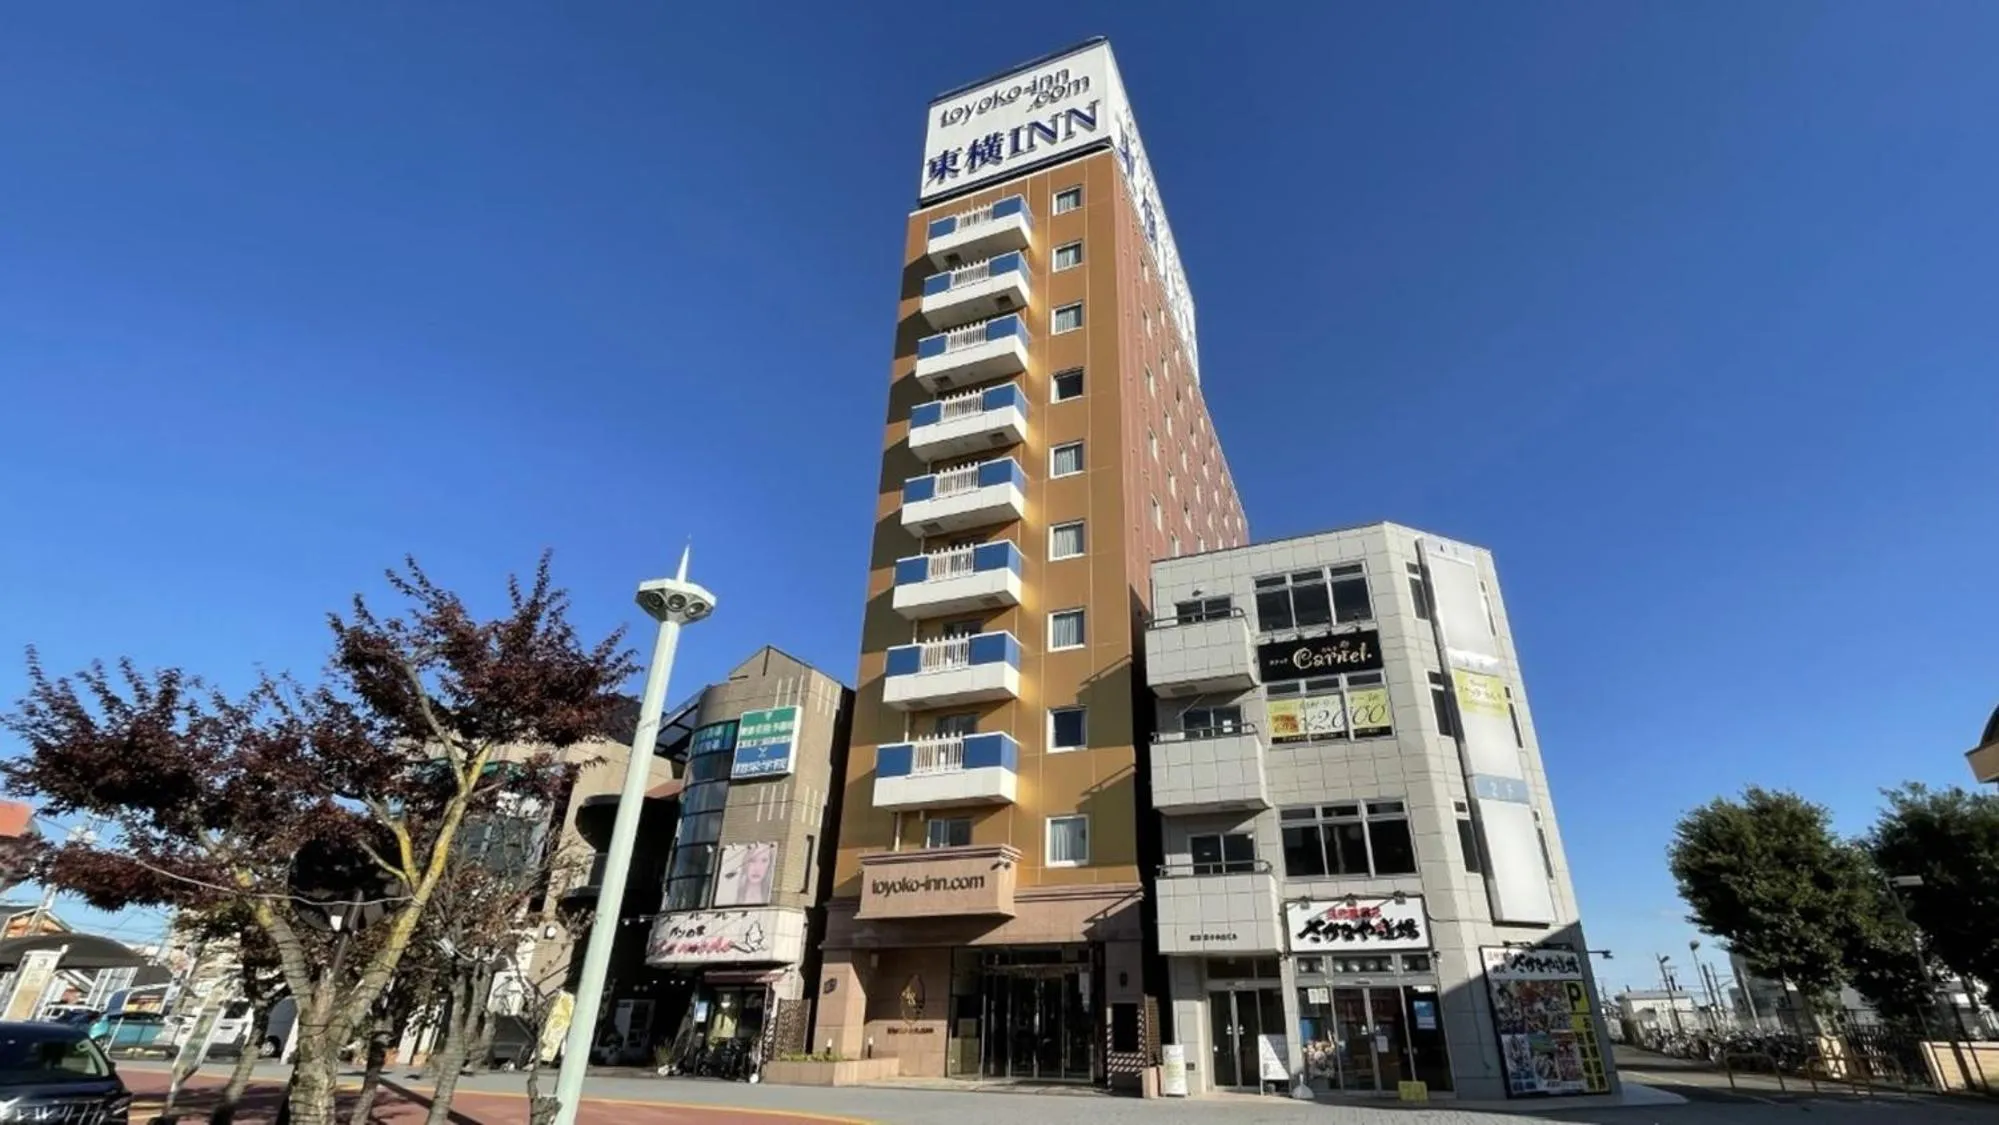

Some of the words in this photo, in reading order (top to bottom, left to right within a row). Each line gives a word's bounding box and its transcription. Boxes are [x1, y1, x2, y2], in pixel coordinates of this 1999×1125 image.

[940, 68, 1070, 128] toyoko-inn
[925, 99, 1101, 187] 東横INN
[871, 874, 985, 898] toyoko-inn.com
[1566, 982, 1581, 1011] P
